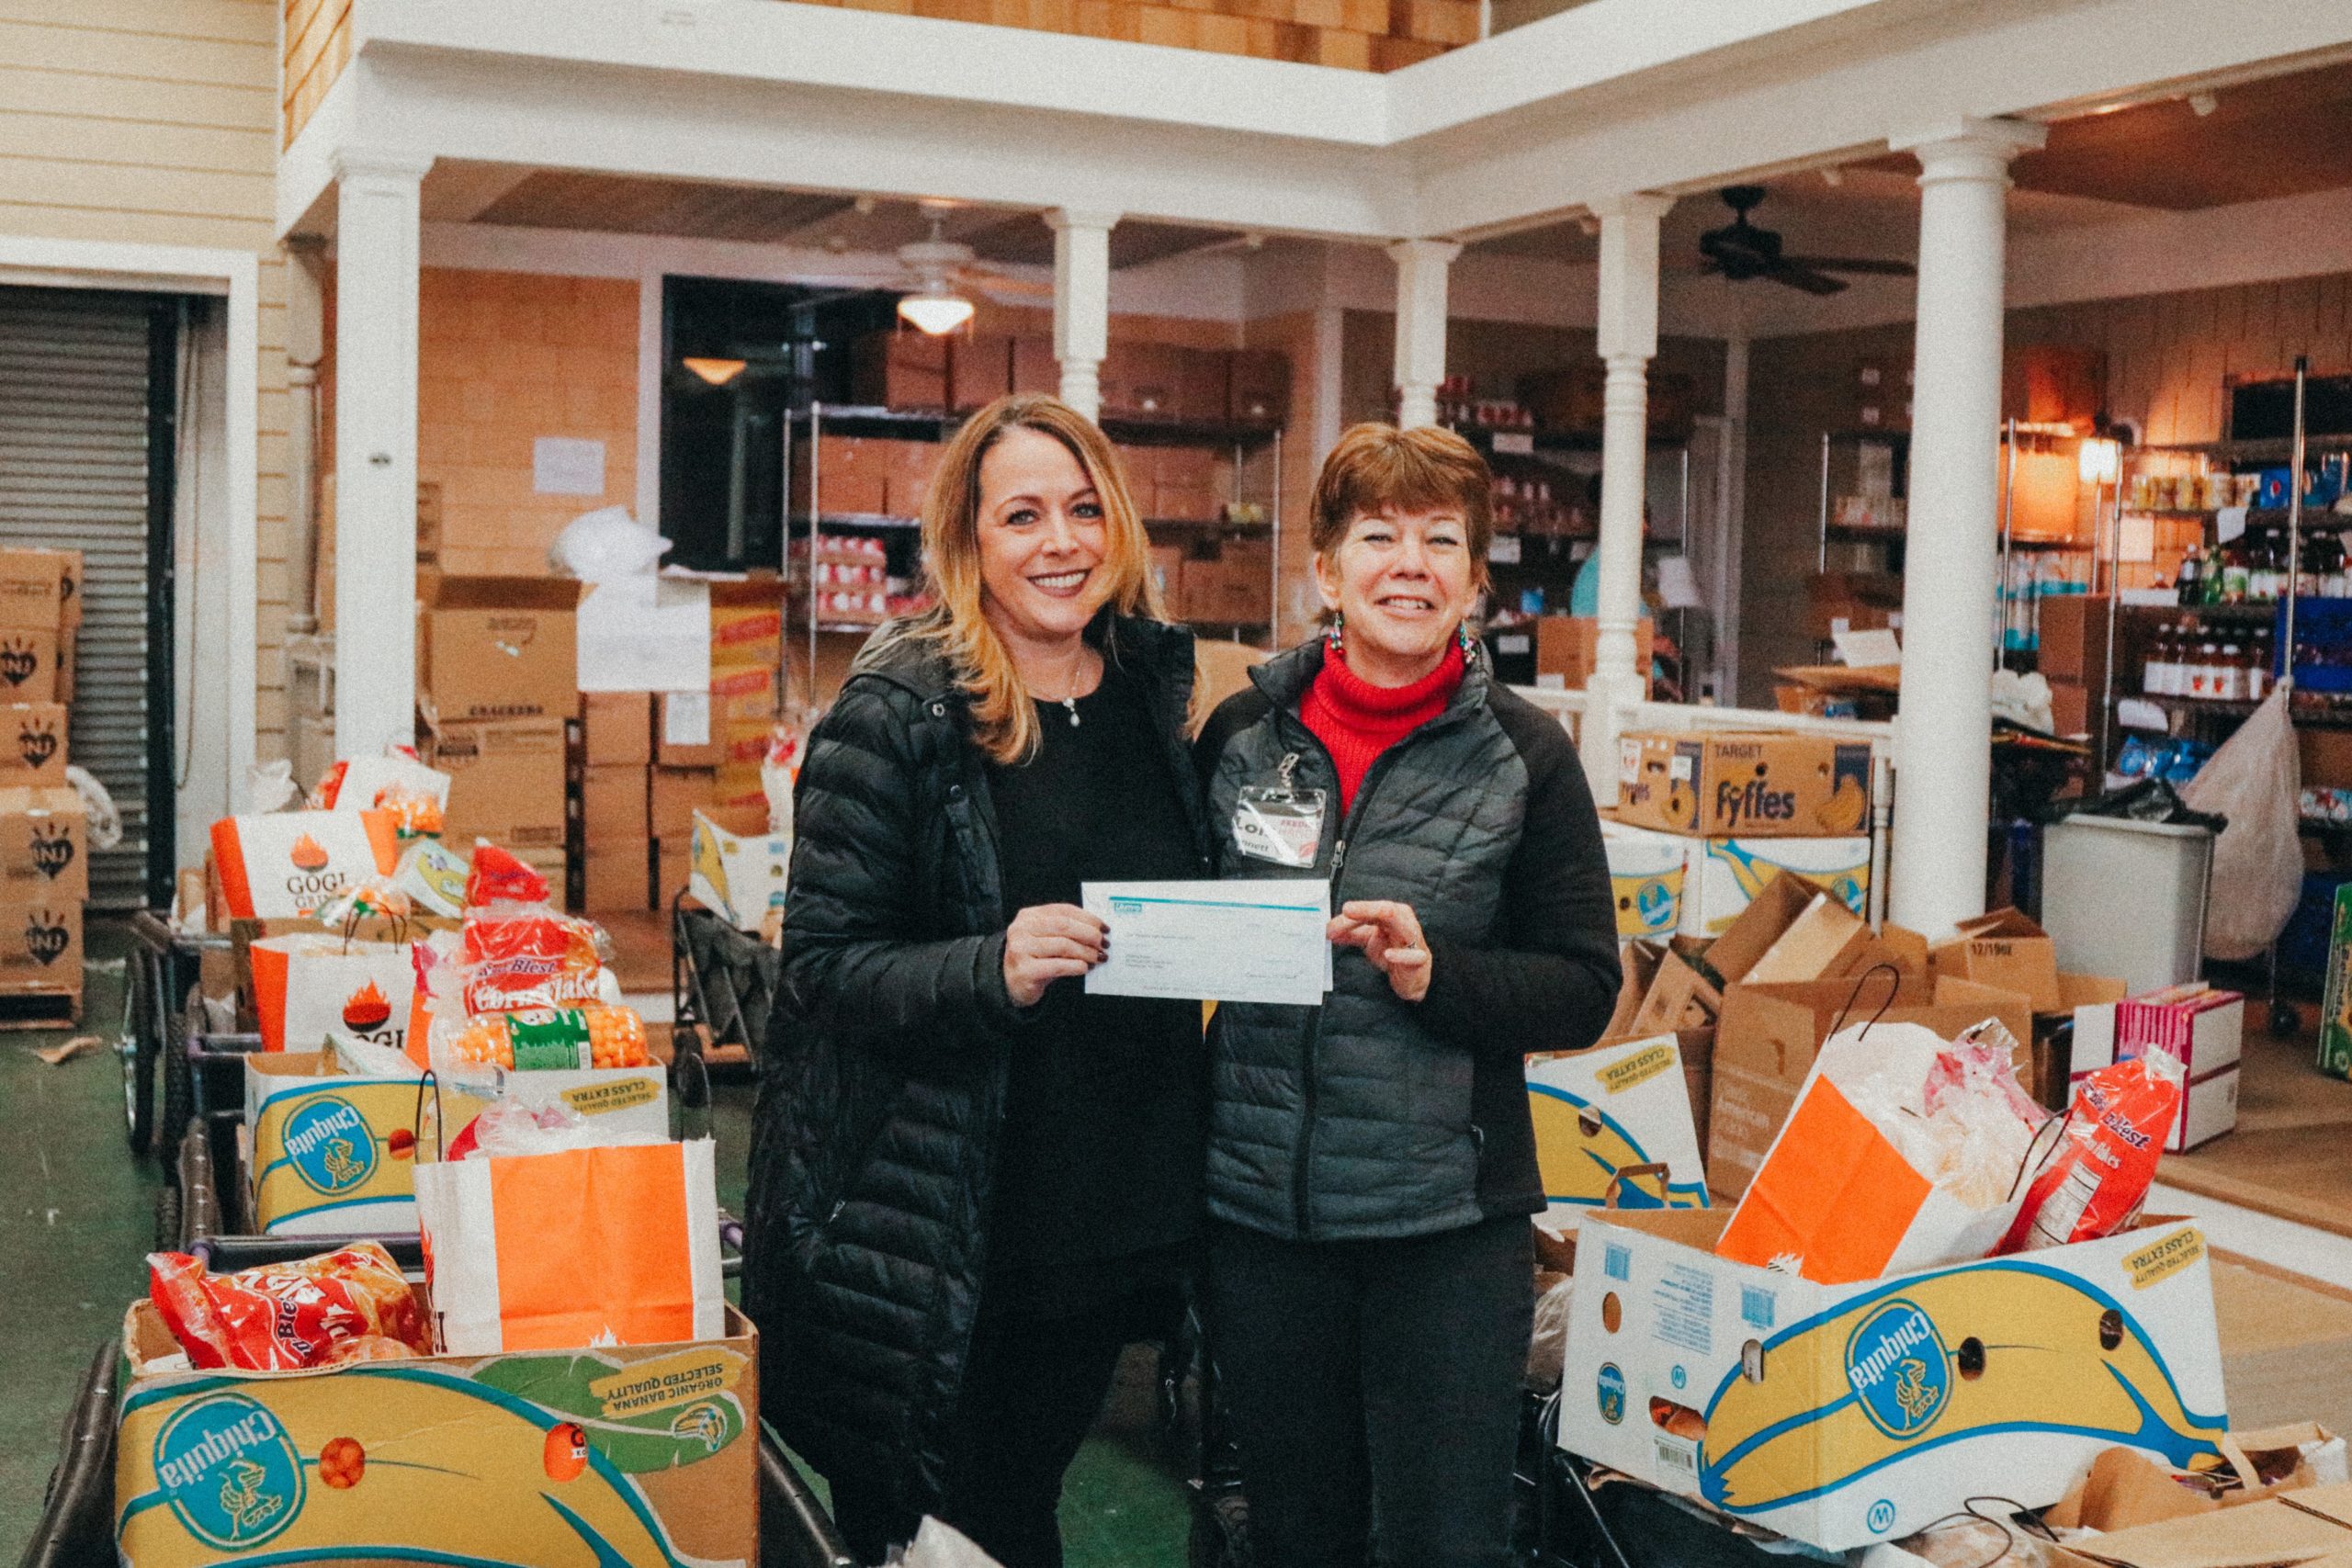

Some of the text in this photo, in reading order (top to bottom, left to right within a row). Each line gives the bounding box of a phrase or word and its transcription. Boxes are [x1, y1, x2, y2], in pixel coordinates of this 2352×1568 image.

[1714, 743, 1762, 758] TARGET
[1714, 780, 1794, 827] fyffes
[572, 1081, 646, 1102] CLASS EXTRA
[285, 1105, 360, 1156] Chiquita
[2132, 1230, 2194, 1269] CLASS EXTRA
[1849, 1310, 1932, 1390] Chiquita
[607, 1362, 723, 1401] SELECTED QUALITY
[613, 1376, 723, 1411] ORGANIC BANANA
[159, 1410, 277, 1488] Chiquita
